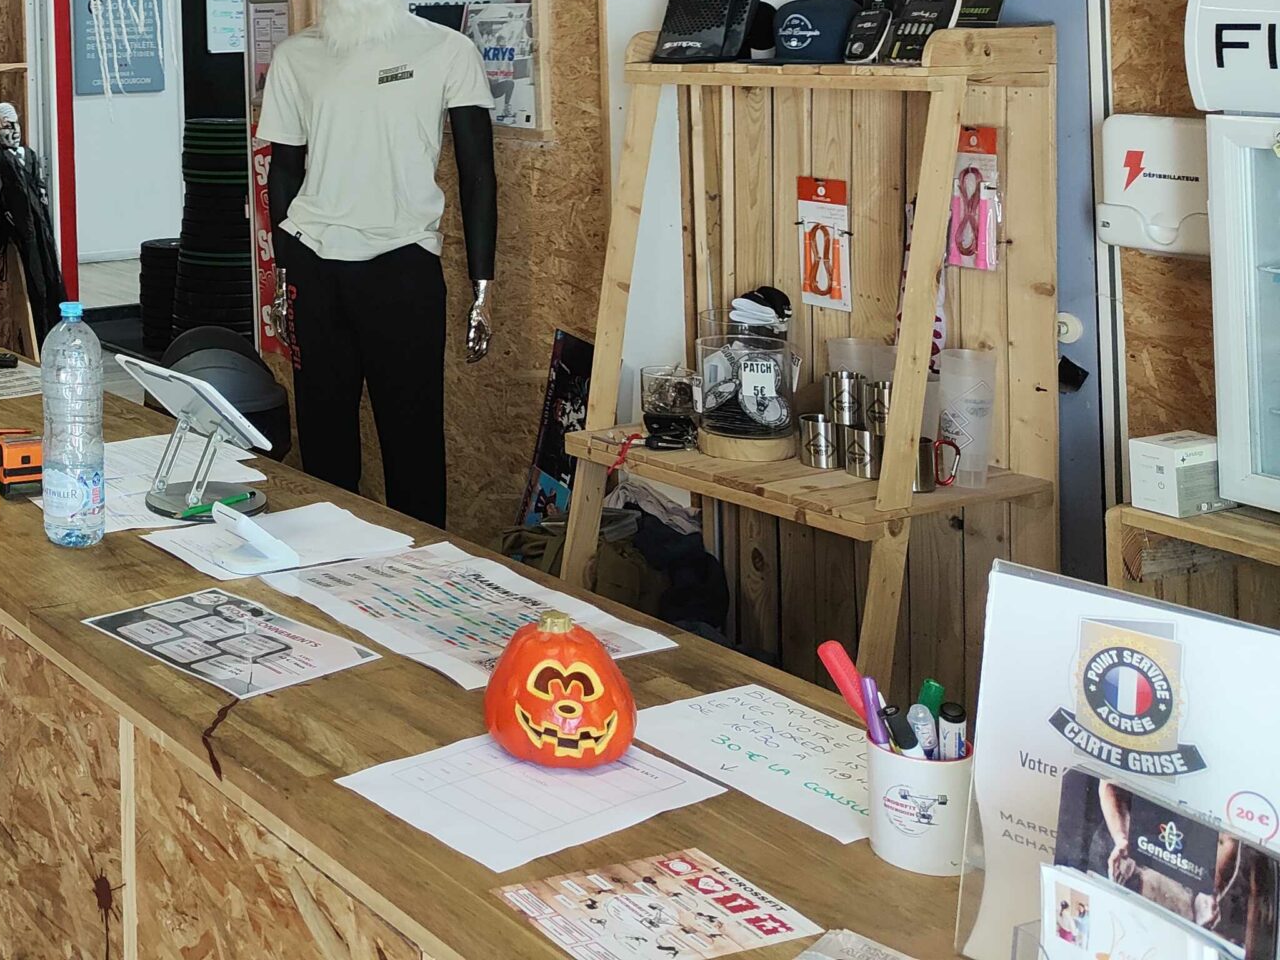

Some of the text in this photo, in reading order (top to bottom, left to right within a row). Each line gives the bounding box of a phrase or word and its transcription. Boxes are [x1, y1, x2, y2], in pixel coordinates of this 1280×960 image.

[483, 46, 516, 62] KRYS
[1142, 171, 1200, 183] DÉFIBRILLATEUR
[743, 362, 772, 374] PATCH
[753, 385, 767, 397] 5€
[1087, 650, 1170, 700] POINT SERVICE
[687, 702, 713, 716] DE
[707, 699, 729, 710] LE
[744, 690, 841, 730] BLOQUEZ
[727, 695, 775, 717] AVEC
[787, 720, 851, 750] VOTRE
[1096, 705, 1156, 733] AGRÉE
[711, 734, 742, 752] 30
[1063, 721, 1189, 774] CARTE GRISE
[1019, 750, 1059, 778] Votre
[1235, 806, 1255, 822] 20
[712, 865, 789, 913] LE CROSSFIT
